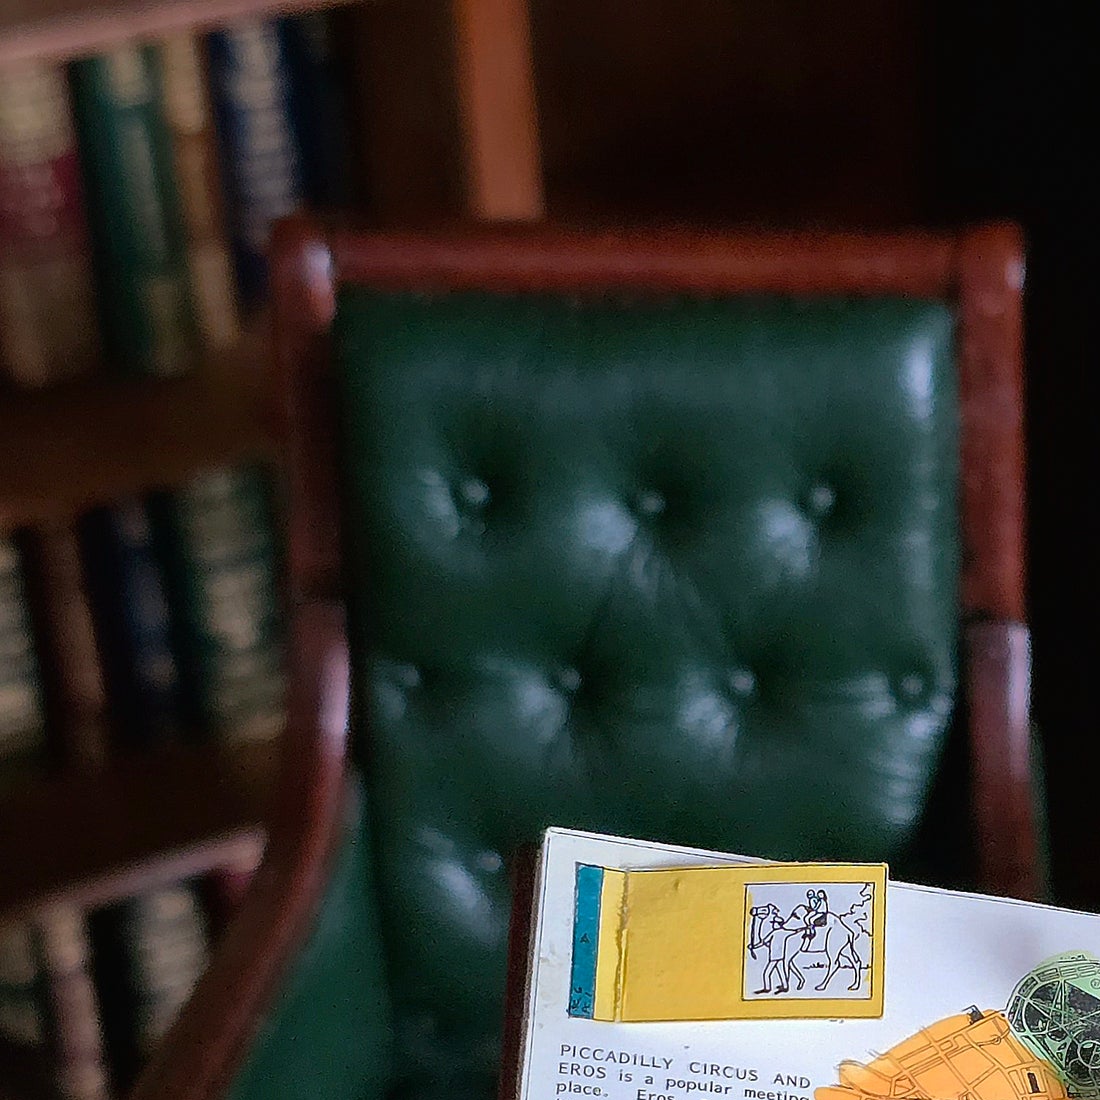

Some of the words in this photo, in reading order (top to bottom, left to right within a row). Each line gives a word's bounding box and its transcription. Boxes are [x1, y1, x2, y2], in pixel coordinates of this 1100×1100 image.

[559, 1062, 607, 1079] EROS
[619, 1069, 633, 1082] is
[644, 1075, 654, 1085] a
[666, 1077, 732, 1095] popular
[560, 1045, 673, 1069] PICCADILLY
[689, 1062, 759, 1081] CIRCUS
[774, 1073, 811, 1089] AND
[556, 1081, 608, 1097] place.
